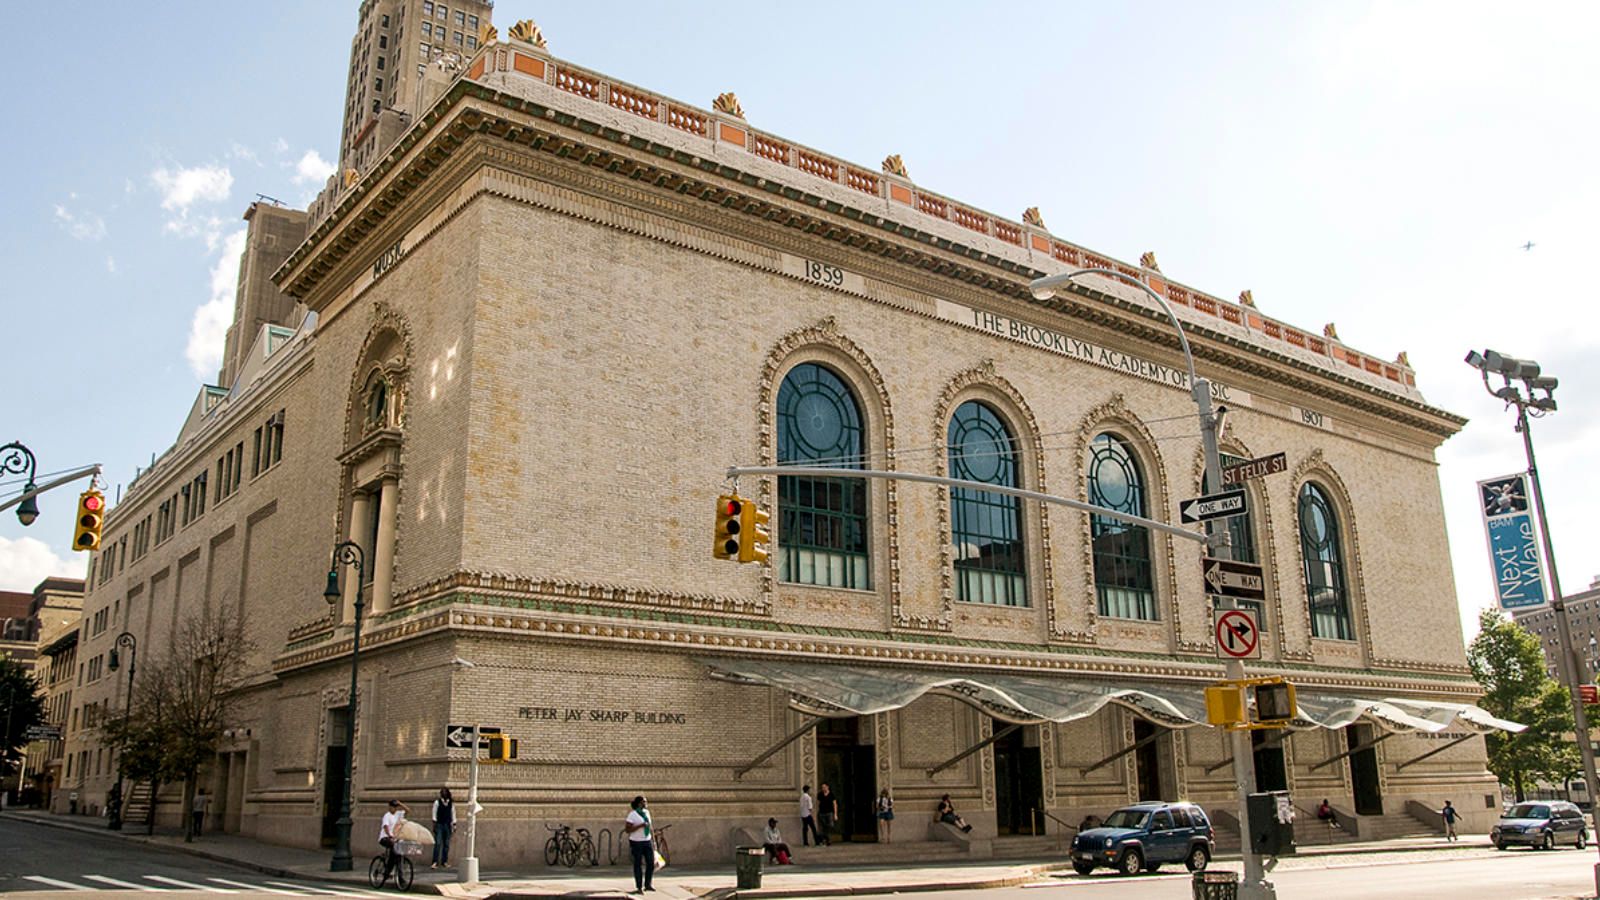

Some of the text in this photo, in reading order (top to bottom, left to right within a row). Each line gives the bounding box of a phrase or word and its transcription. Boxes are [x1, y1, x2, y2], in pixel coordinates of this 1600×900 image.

[373, 240, 406, 279] MUSIC
[805, 259, 844, 286] 1859
[972, 309, 1231, 400] THE BROOKLYN ACADEMY OF SIC
[1301, 409, 1324, 427] 1907
[1223, 468, 1237, 484] ST
[1240, 460, 1269, 480] FELIX
[1272, 456, 1285, 472] ST
[1199, 497, 1240, 514] ONE WAY
[1520, 522, 1542, 586] Wave
[1209, 571, 1259, 587] ONE WAY
[1495, 545, 1525, 599] Next
[519, 707, 686, 724] PETER JAY SHARP BUILDING
